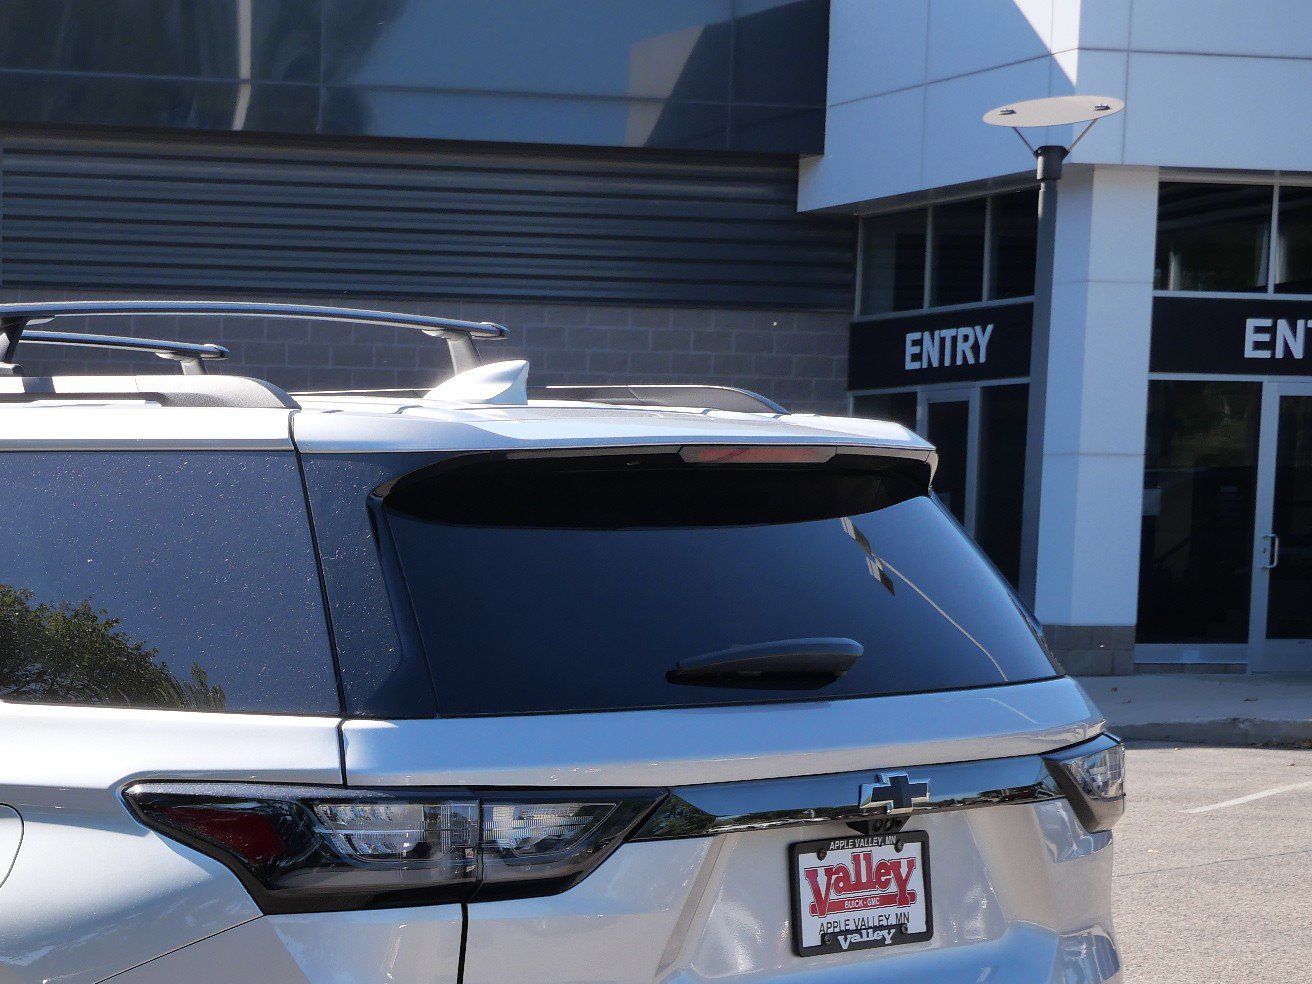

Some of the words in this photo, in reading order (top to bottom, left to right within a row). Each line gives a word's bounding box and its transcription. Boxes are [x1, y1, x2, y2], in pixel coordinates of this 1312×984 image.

[904, 324, 994, 370] ENTRY
[1243, 318, 1312, 359] EN
[829, 839, 854, 851] APPLE
[819, 918, 851, 936] APPLE
[895, 911, 910, 924] MN
